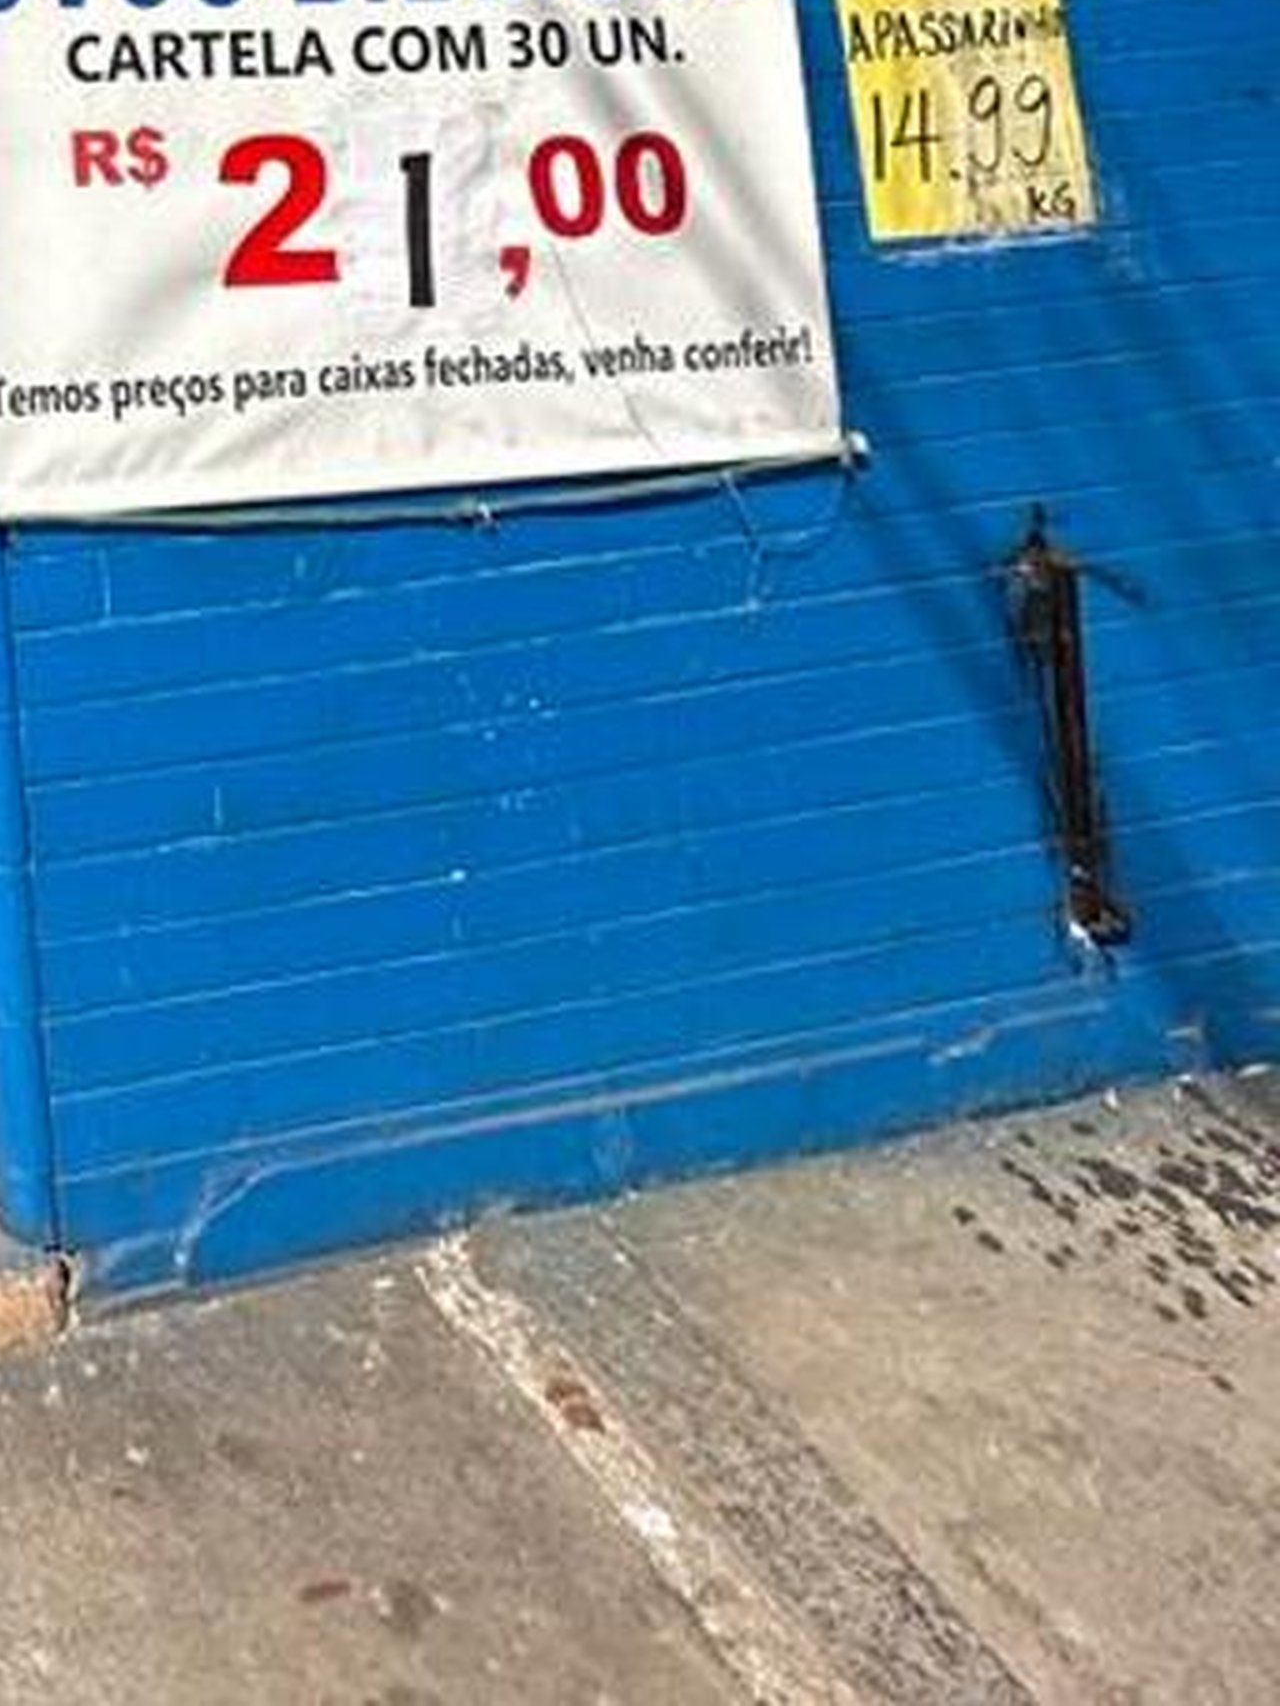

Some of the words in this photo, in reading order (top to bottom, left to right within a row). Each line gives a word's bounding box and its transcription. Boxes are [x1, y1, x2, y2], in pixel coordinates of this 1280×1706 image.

[66, 30, 334, 83] CARTELA
[352, 24, 487, 74] COM
[508, 21, 569, 70] 30
[587, 17, 686, 65] UN.
[71, 127, 169, 190] R$
[873, 74, 1052, 183] 14.99
[1028, 182, 1077, 224] KG
[110, 370, 226, 423] preços
[235, 369, 309, 408] para
[317, 354, 416, 397] caixas
[423, 344, 577, 391] fechadas,
[580, 332, 675, 380] venha
[683, 325, 814, 373] conferir!
